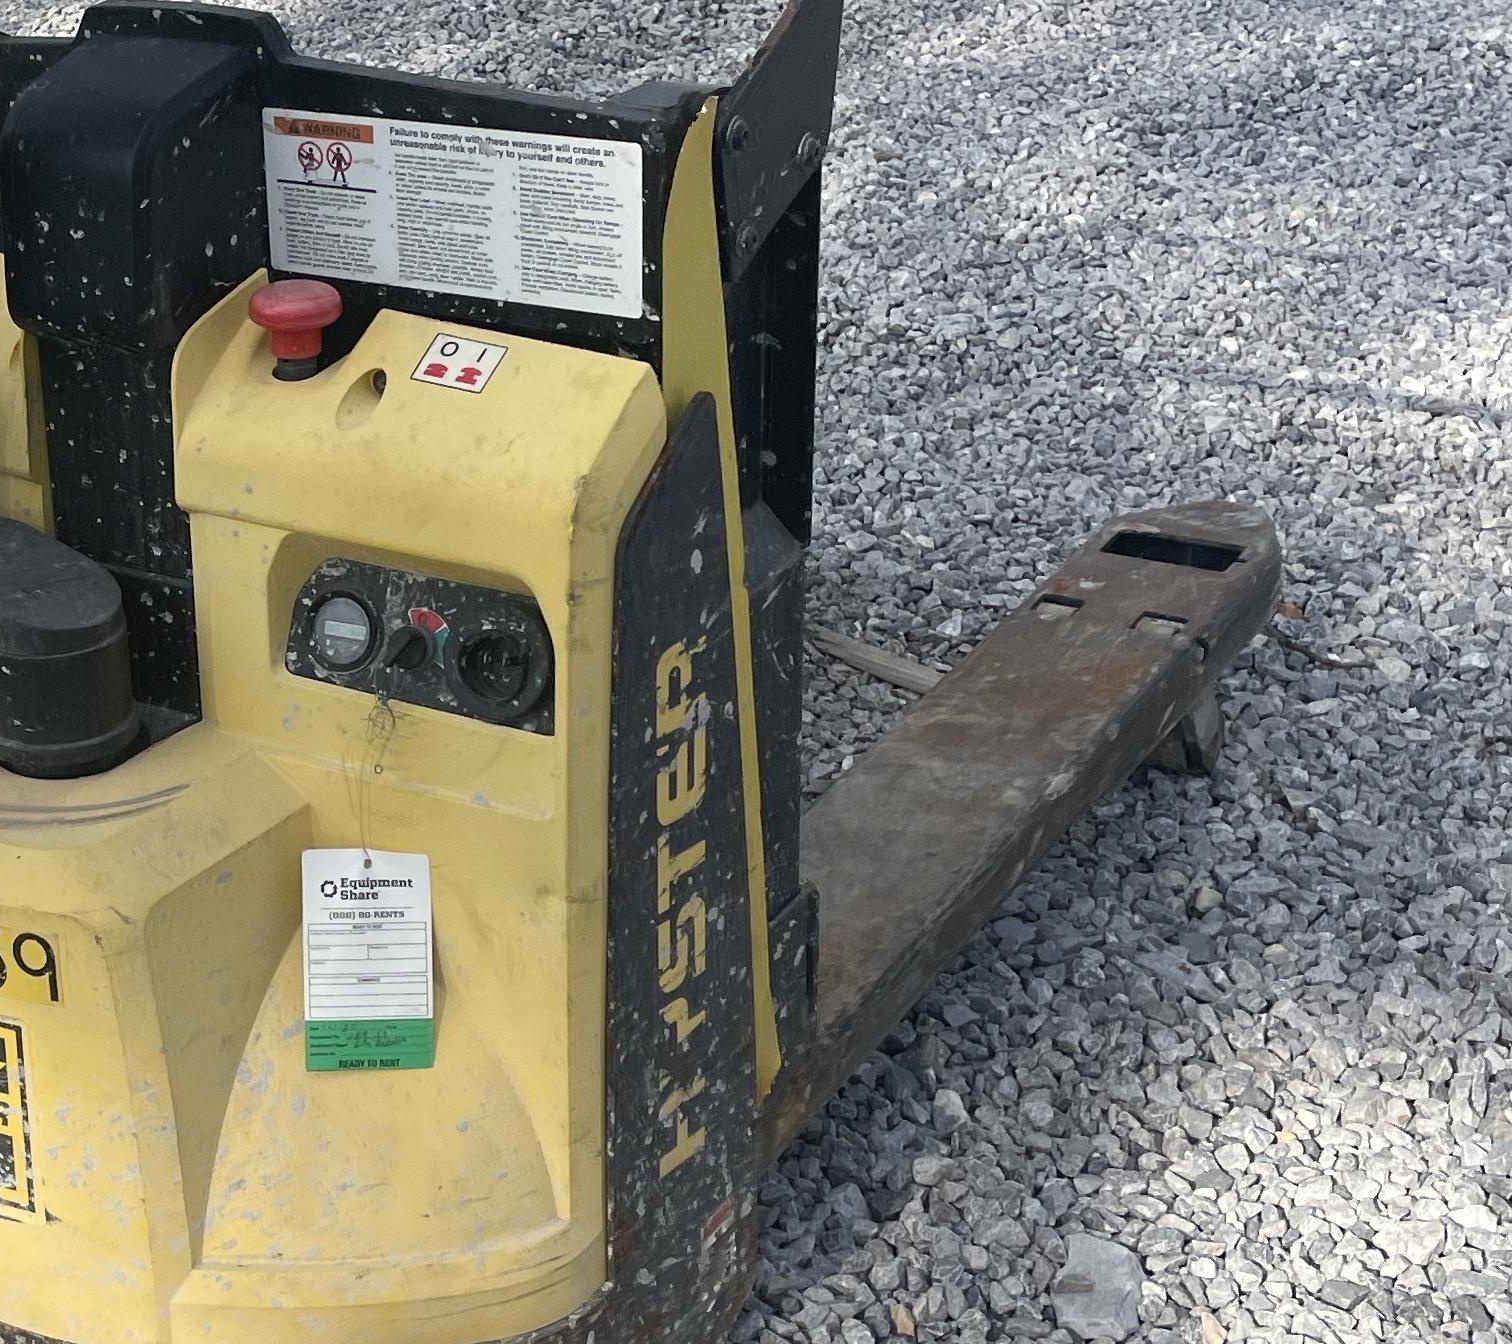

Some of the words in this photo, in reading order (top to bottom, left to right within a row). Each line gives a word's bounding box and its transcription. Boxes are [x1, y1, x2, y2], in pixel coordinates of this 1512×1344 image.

[303, 122, 361, 140] WARNING
[390, 126, 419, 137] Failure
[420, 130, 429, 139] to
[431, 132, 462, 143] comply
[465, 135, 483, 144] with
[511, 140, 553, 152] warnings
[555, 143, 571, 153] will
[573, 145, 601, 156] create
[604, 149, 615, 157] an
[390, 139, 447, 152] unreasonable
[449, 144, 466, 154] risk
[468, 146, 477, 155] of
[506, 150, 515, 159] to
[517, 152, 553, 162] yourself
[556, 156, 572, 165] and
[575, 157, 607, 167] others.
[340, 877, 414, 890] Equipment
[340, 890, 379, 900] Share
[338, 1059, 365, 1069] READY
[367, 1058, 378, 1068] TO
[379, 1058, 401, 1068] RENT
